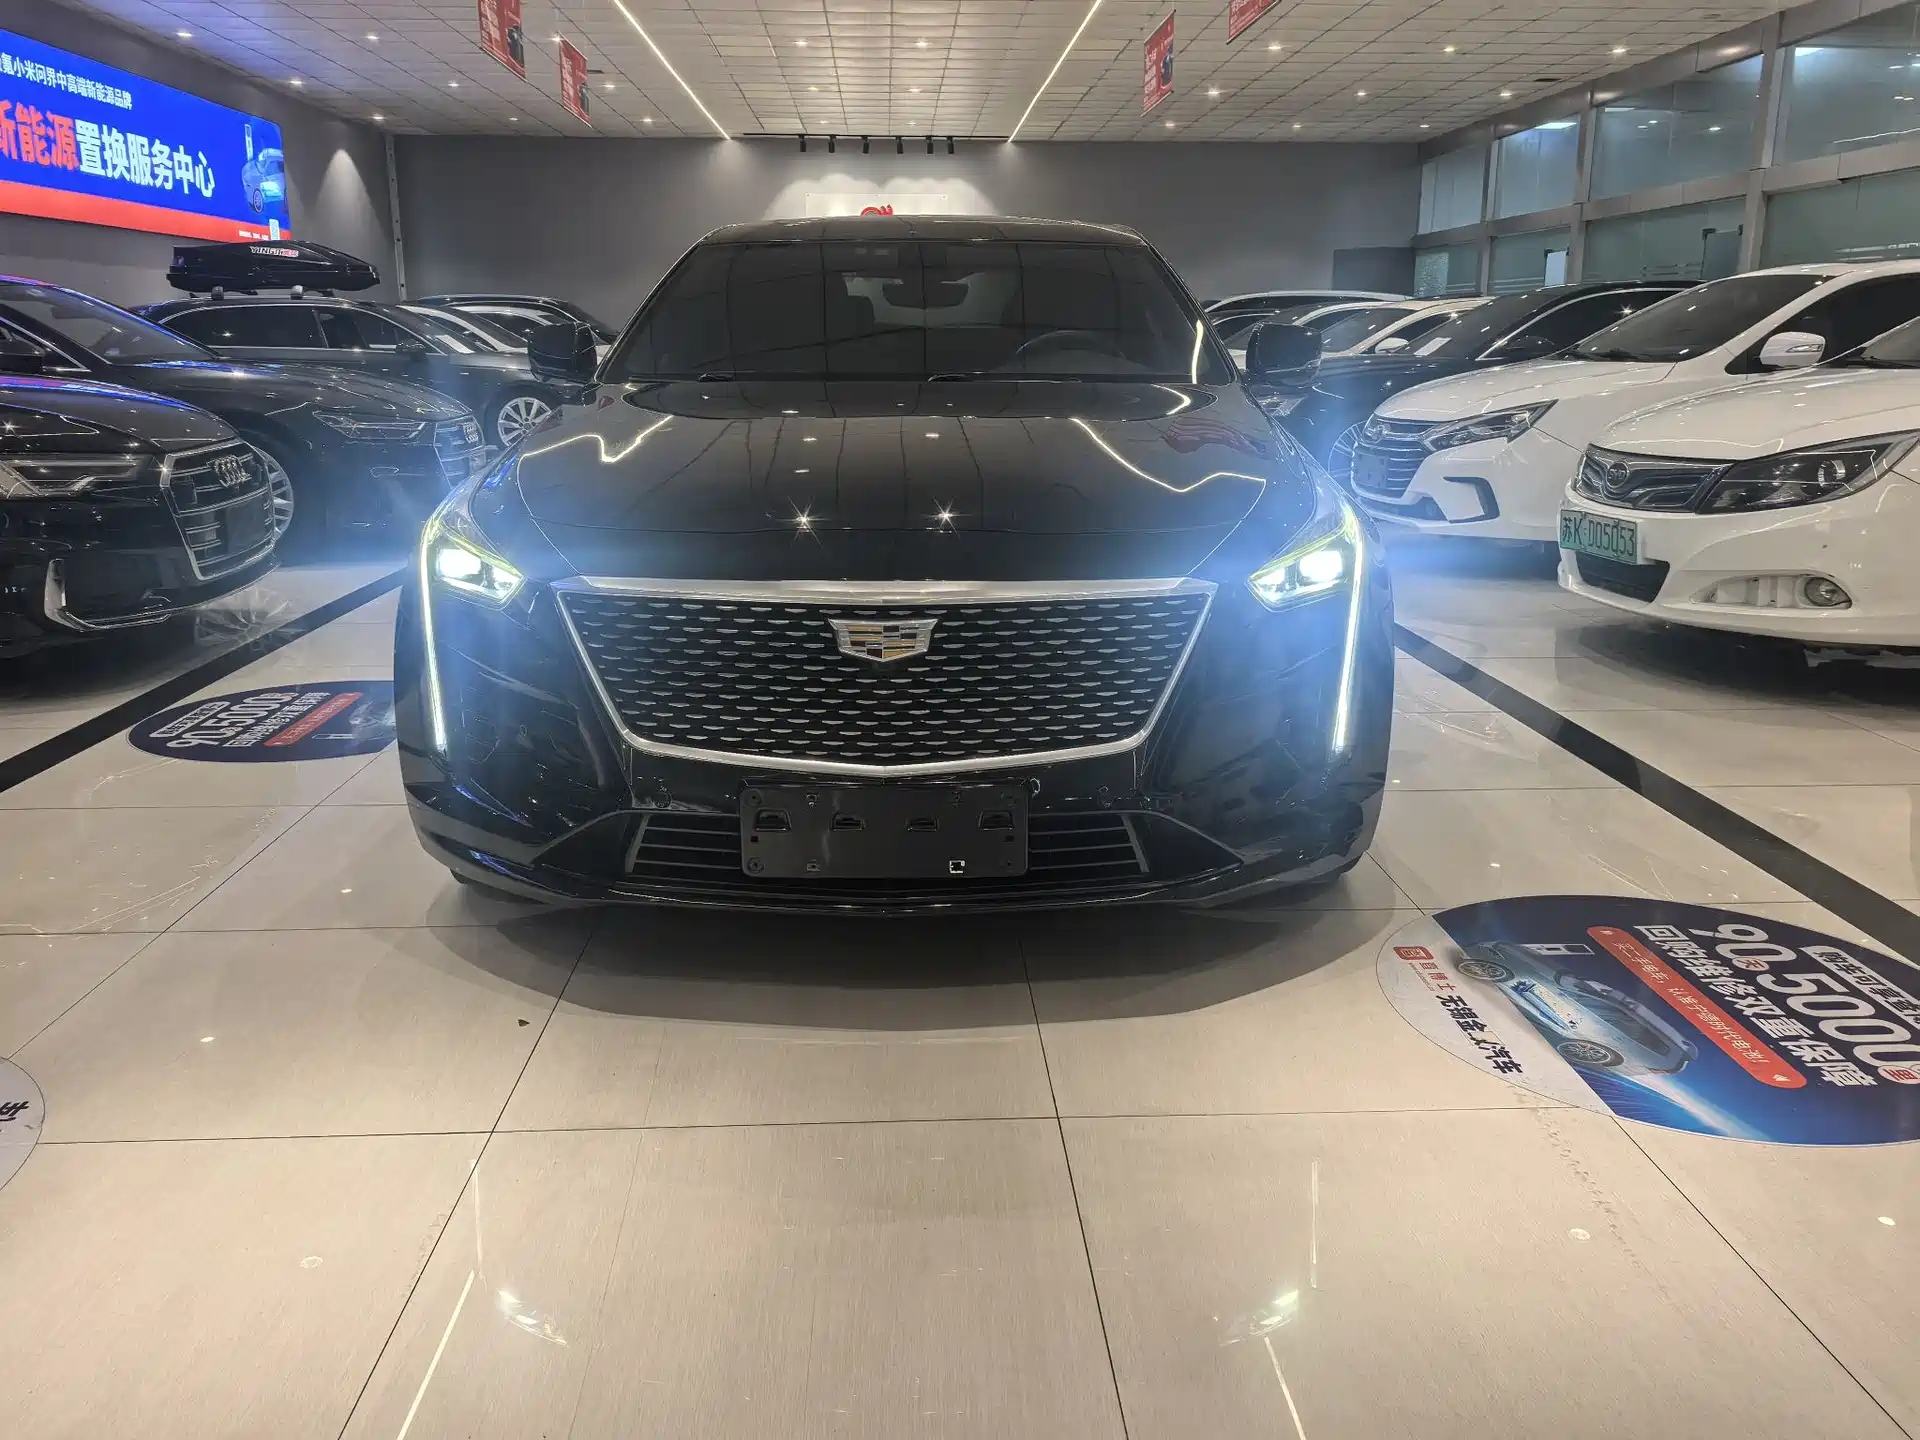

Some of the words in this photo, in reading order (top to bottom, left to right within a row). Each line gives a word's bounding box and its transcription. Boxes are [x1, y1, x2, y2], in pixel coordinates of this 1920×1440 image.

[0, 52, 132, 110] 氪小米问界中高端新能源品牌
[1634, 925, 1878, 1086] 回购维修双重保障
